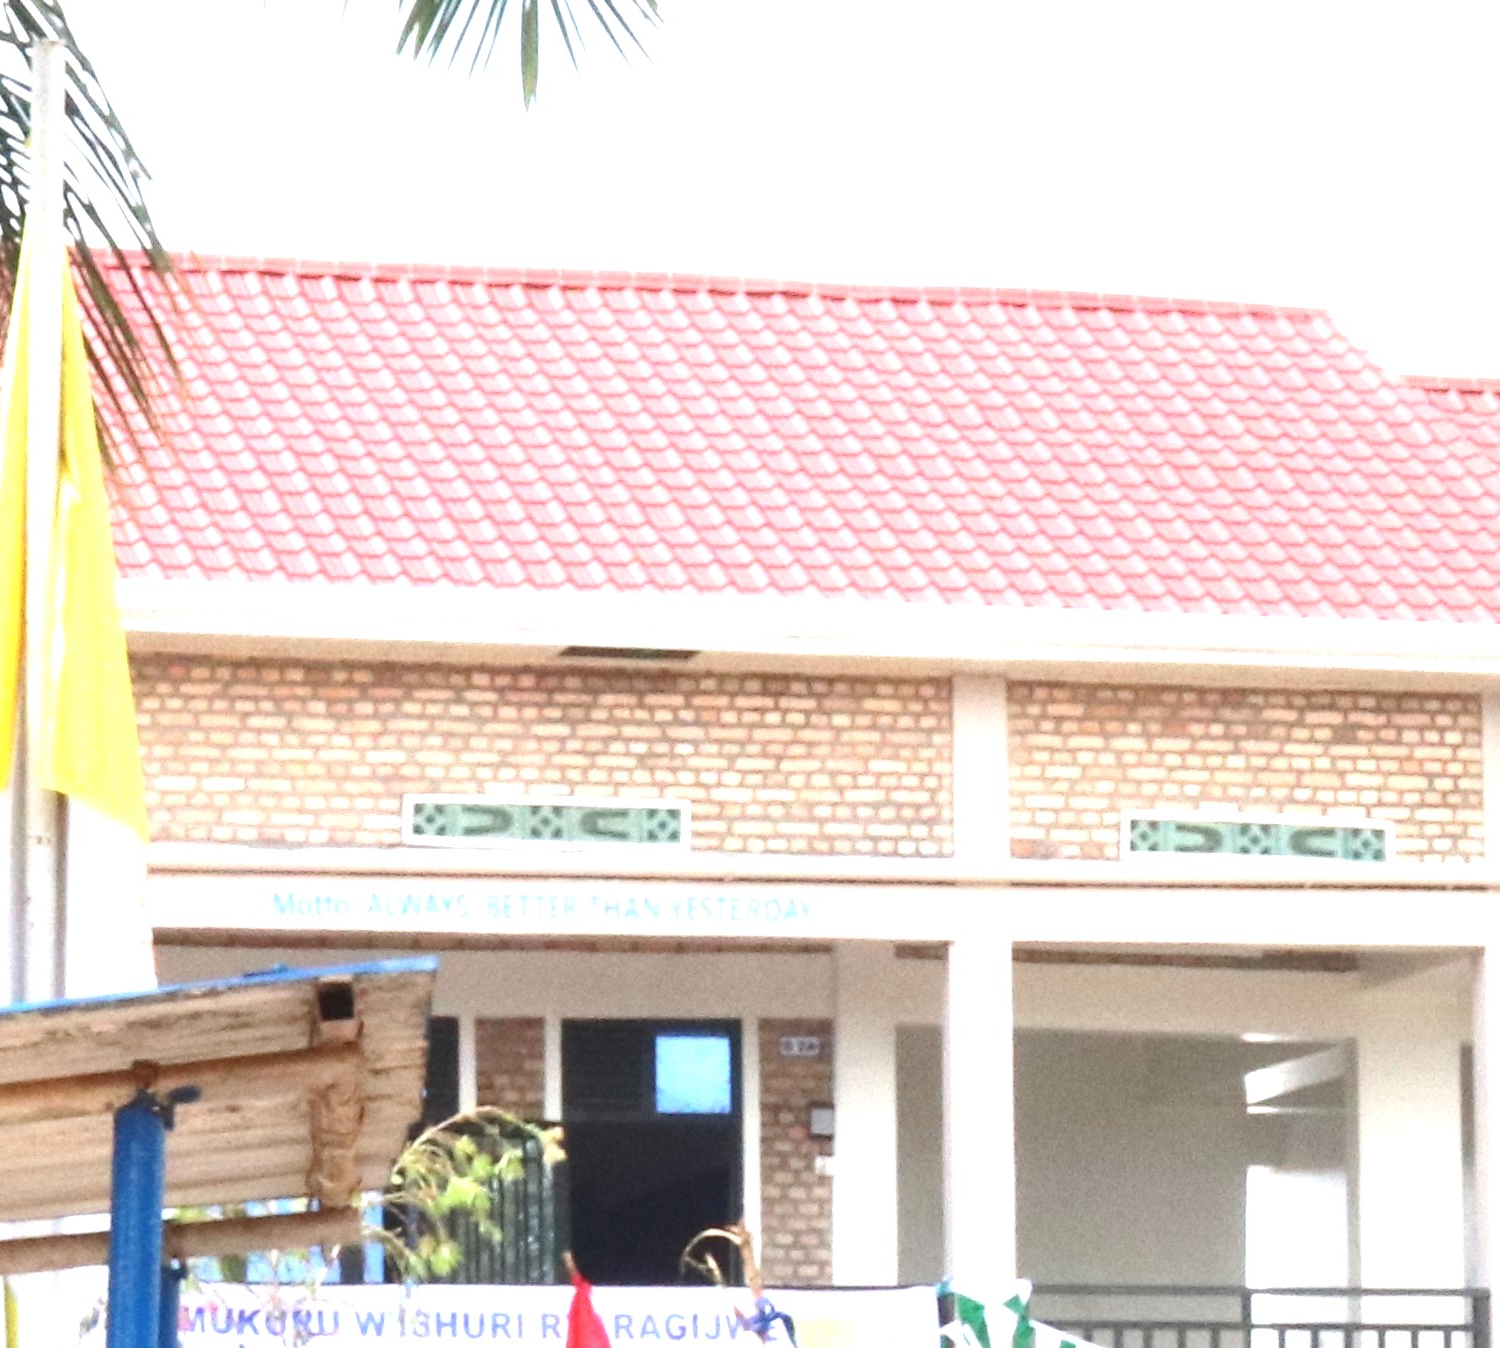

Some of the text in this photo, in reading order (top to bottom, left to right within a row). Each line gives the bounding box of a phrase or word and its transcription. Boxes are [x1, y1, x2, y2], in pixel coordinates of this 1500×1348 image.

[367, 893, 469, 919] ALWAYS
[487, 894, 577, 920] BETTER
[588, 896, 661, 920] THAN
[671, 896, 813, 922] YESTERDAY
